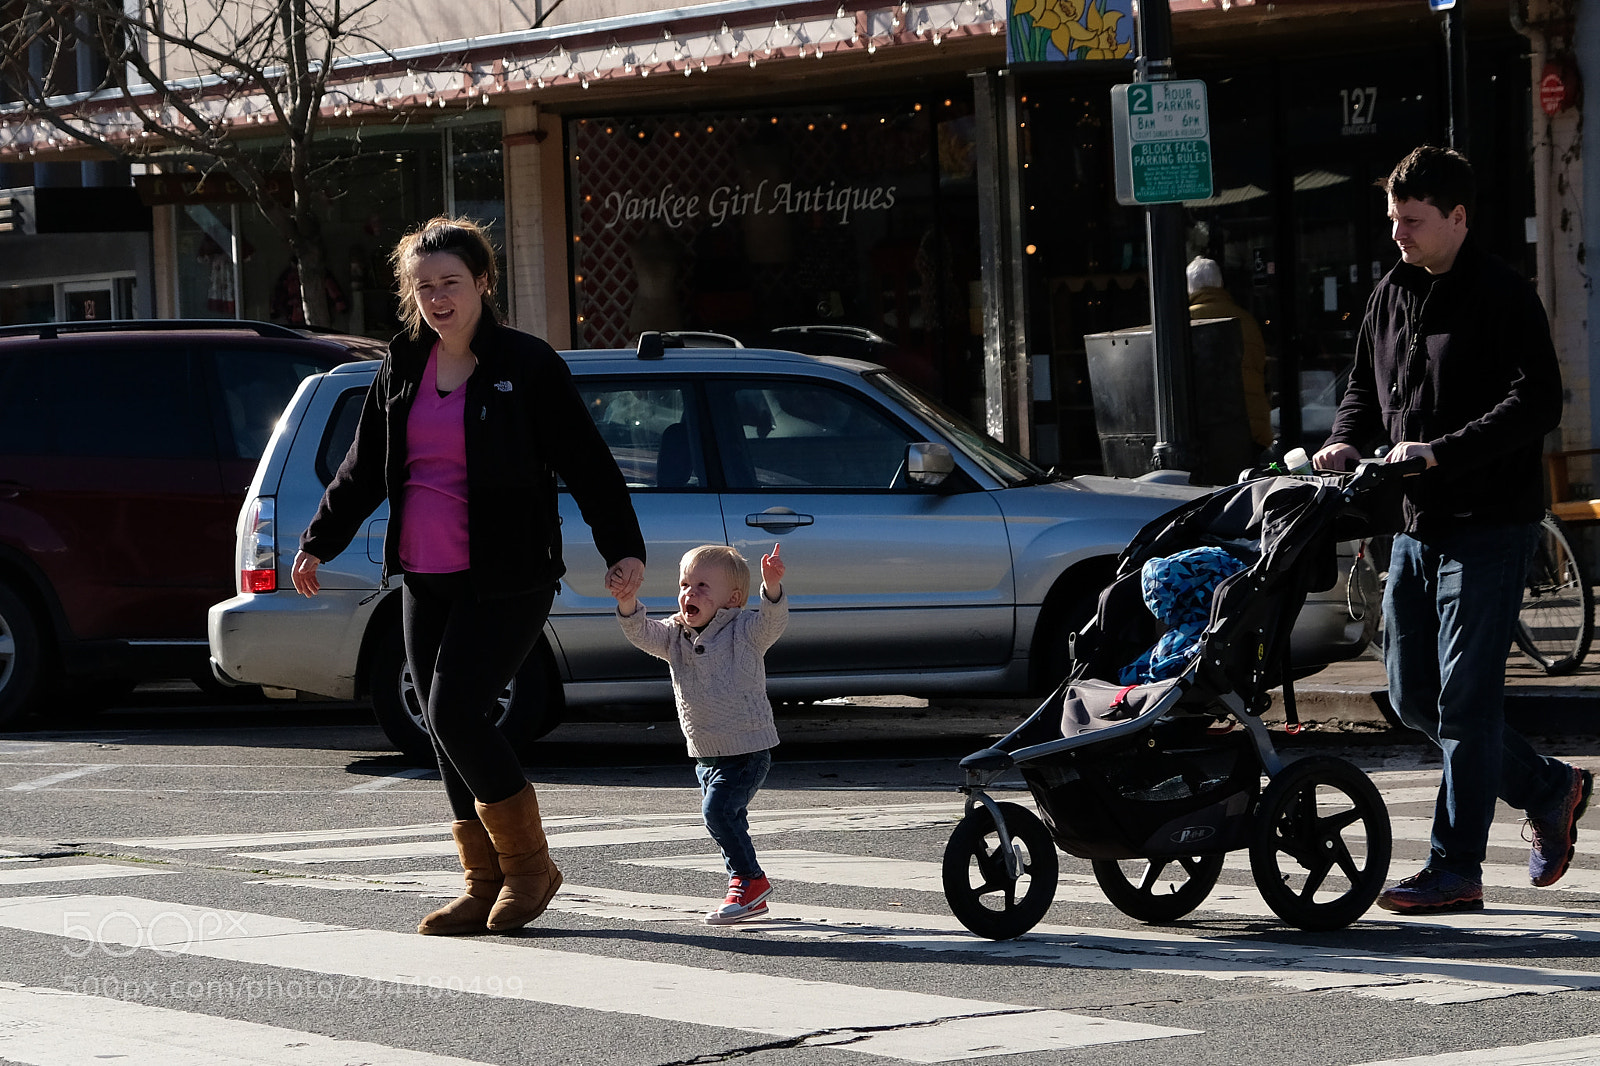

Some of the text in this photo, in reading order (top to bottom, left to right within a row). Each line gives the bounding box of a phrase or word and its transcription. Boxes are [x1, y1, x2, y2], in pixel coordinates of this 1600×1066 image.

[1132, 88, 1148, 111] 2
[1164, 88, 1192, 99] HOUR
[1157, 99, 1200, 112] PARKING
[1339, 86, 1377, 125] 127
[1138, 114, 1199, 129] 8AM TO 6PM
[1142, 141, 1198, 155] BLOCK FACE
[1134, 151, 1207, 166] PARKING RULES
[604, 179, 897, 228] Yankee Girl Antiques
